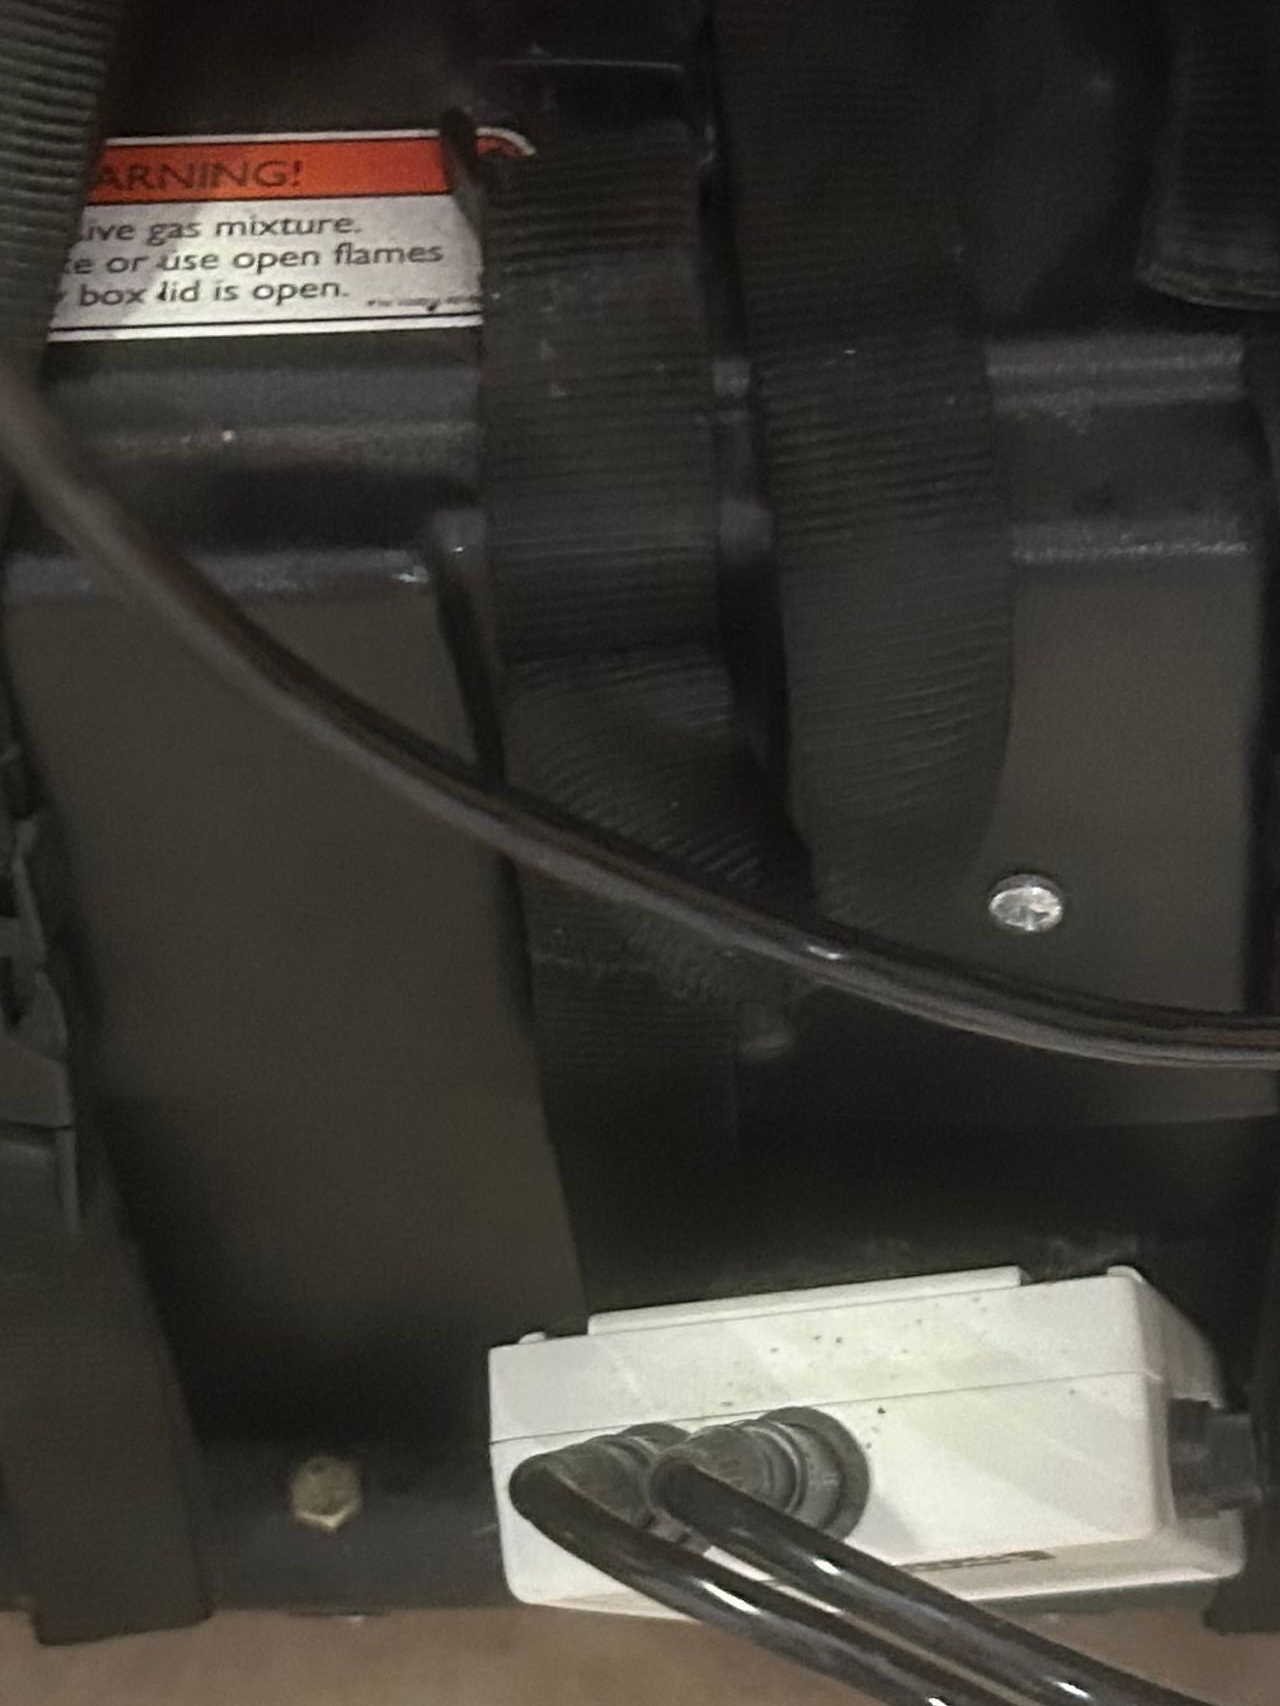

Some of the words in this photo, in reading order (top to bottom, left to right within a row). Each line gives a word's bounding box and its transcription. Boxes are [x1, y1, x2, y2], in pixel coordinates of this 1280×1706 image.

[94, 159, 304, 191] ARNING!
[147, 220, 202, 247] gas
[214, 214, 363, 238] mixture.
[106, 254, 150, 275] or
[156, 250, 220, 273] use
[232, 248, 321, 276] open
[335, 241, 445, 268] flames
[78, 282, 148, 307] box
[155, 279, 201, 304] lid
[213, 278, 240, 302] is
[252, 280, 350, 307] open.
